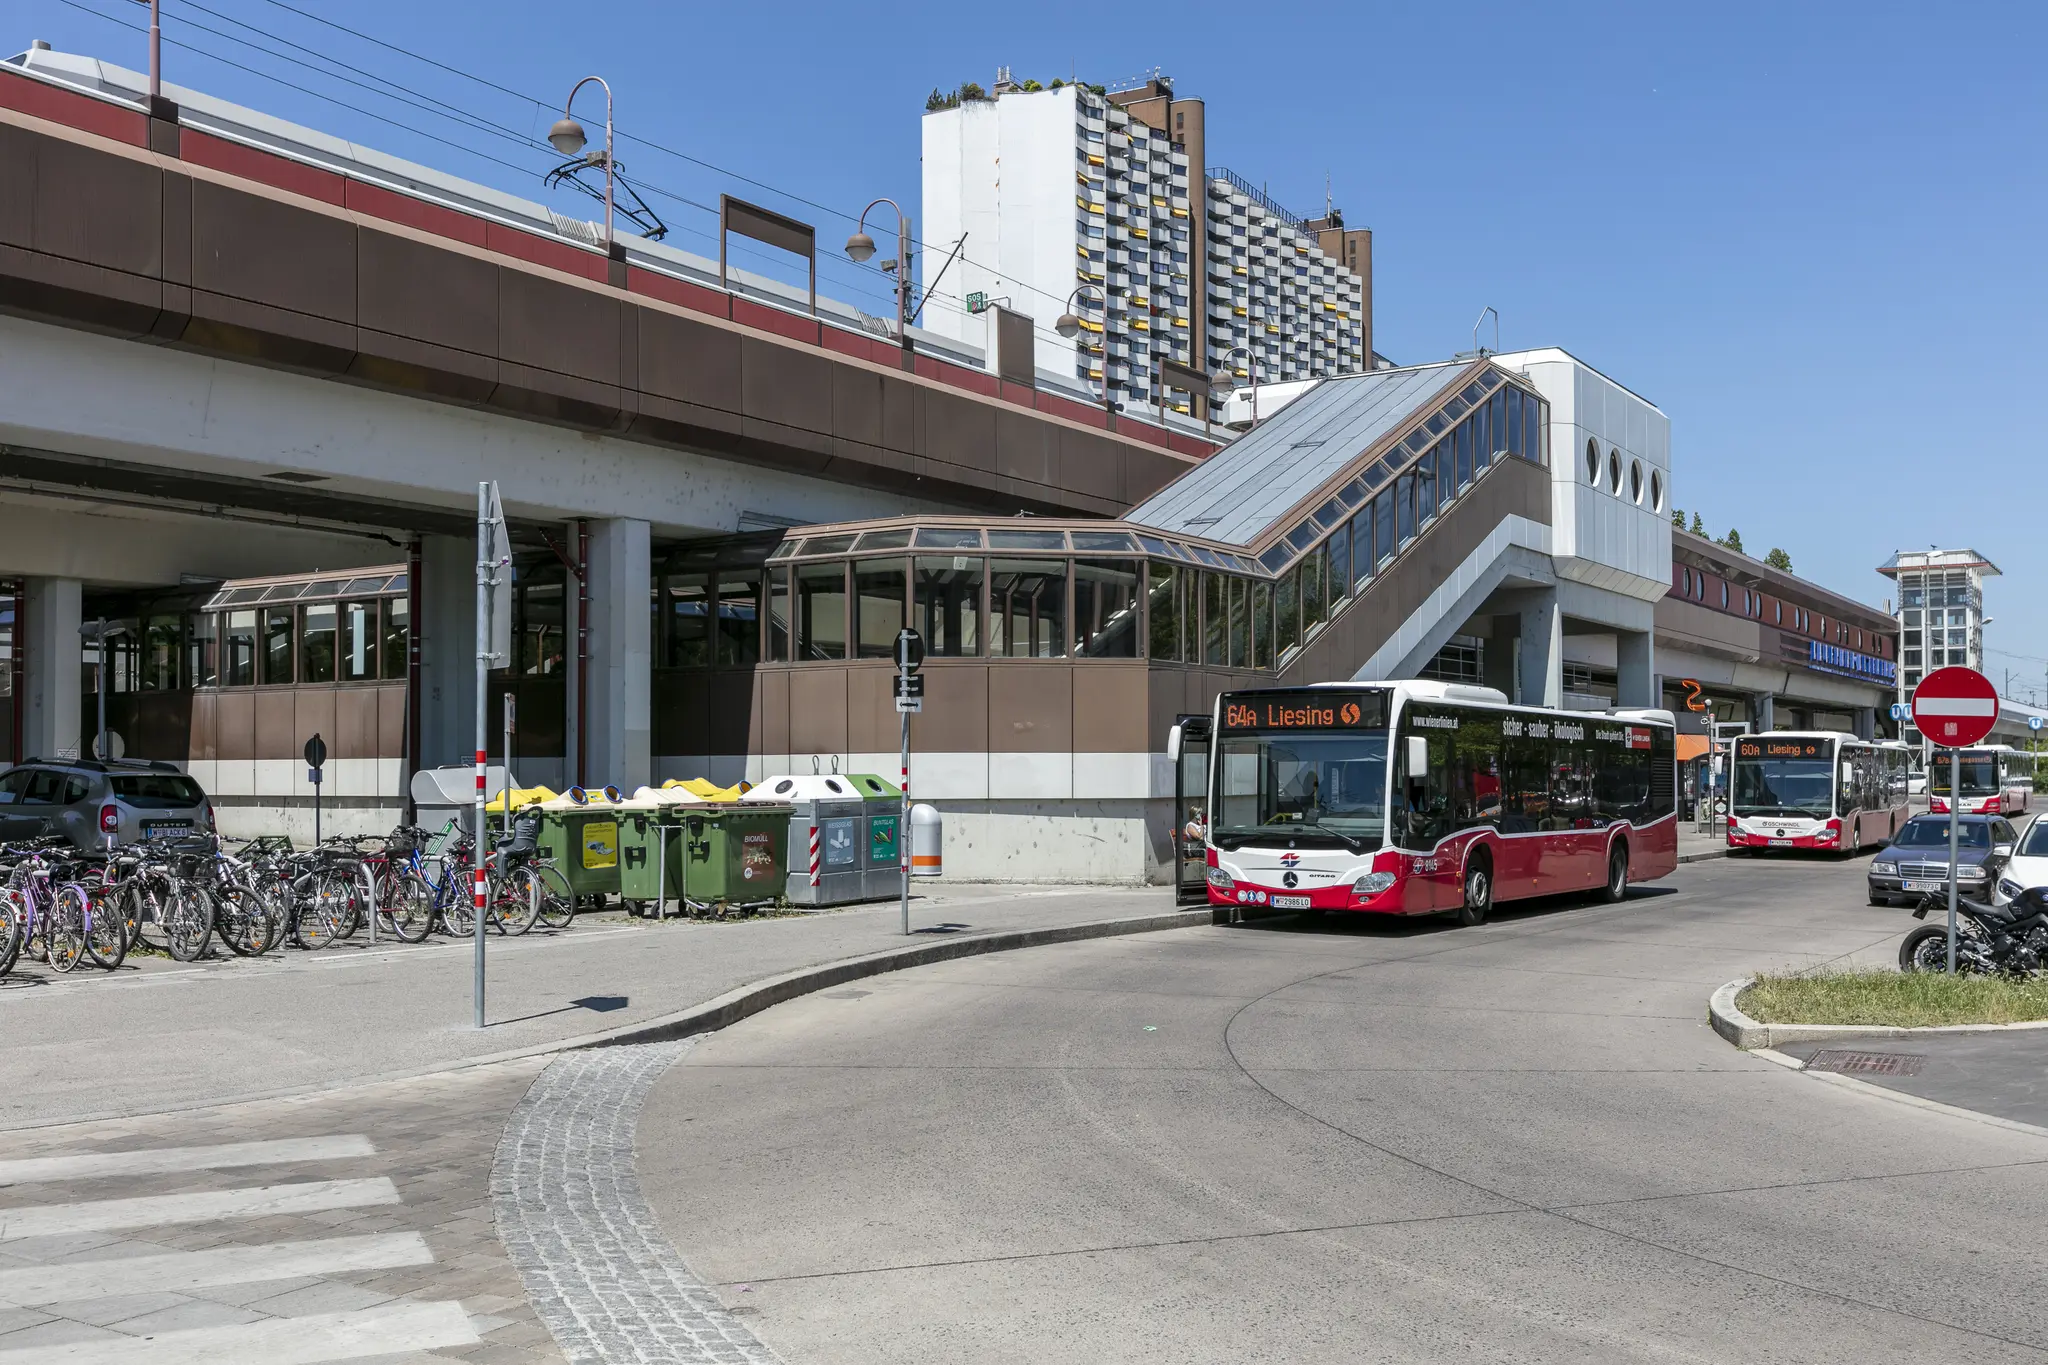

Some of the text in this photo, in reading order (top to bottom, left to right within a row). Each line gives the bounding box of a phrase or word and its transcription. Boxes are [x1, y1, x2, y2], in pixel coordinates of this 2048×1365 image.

[968, 293, 981, 303] SOS
[1227, 704, 1334, 727] 64A Liesing
[1412, 714, 1459, 729] www.wienerlinien.at
[1502, 716, 1584, 744] sicher sauber ökologisch
[1741, 744, 1801, 756] 60A Liesing
[744, 833, 769, 843] BIOMÜLL
